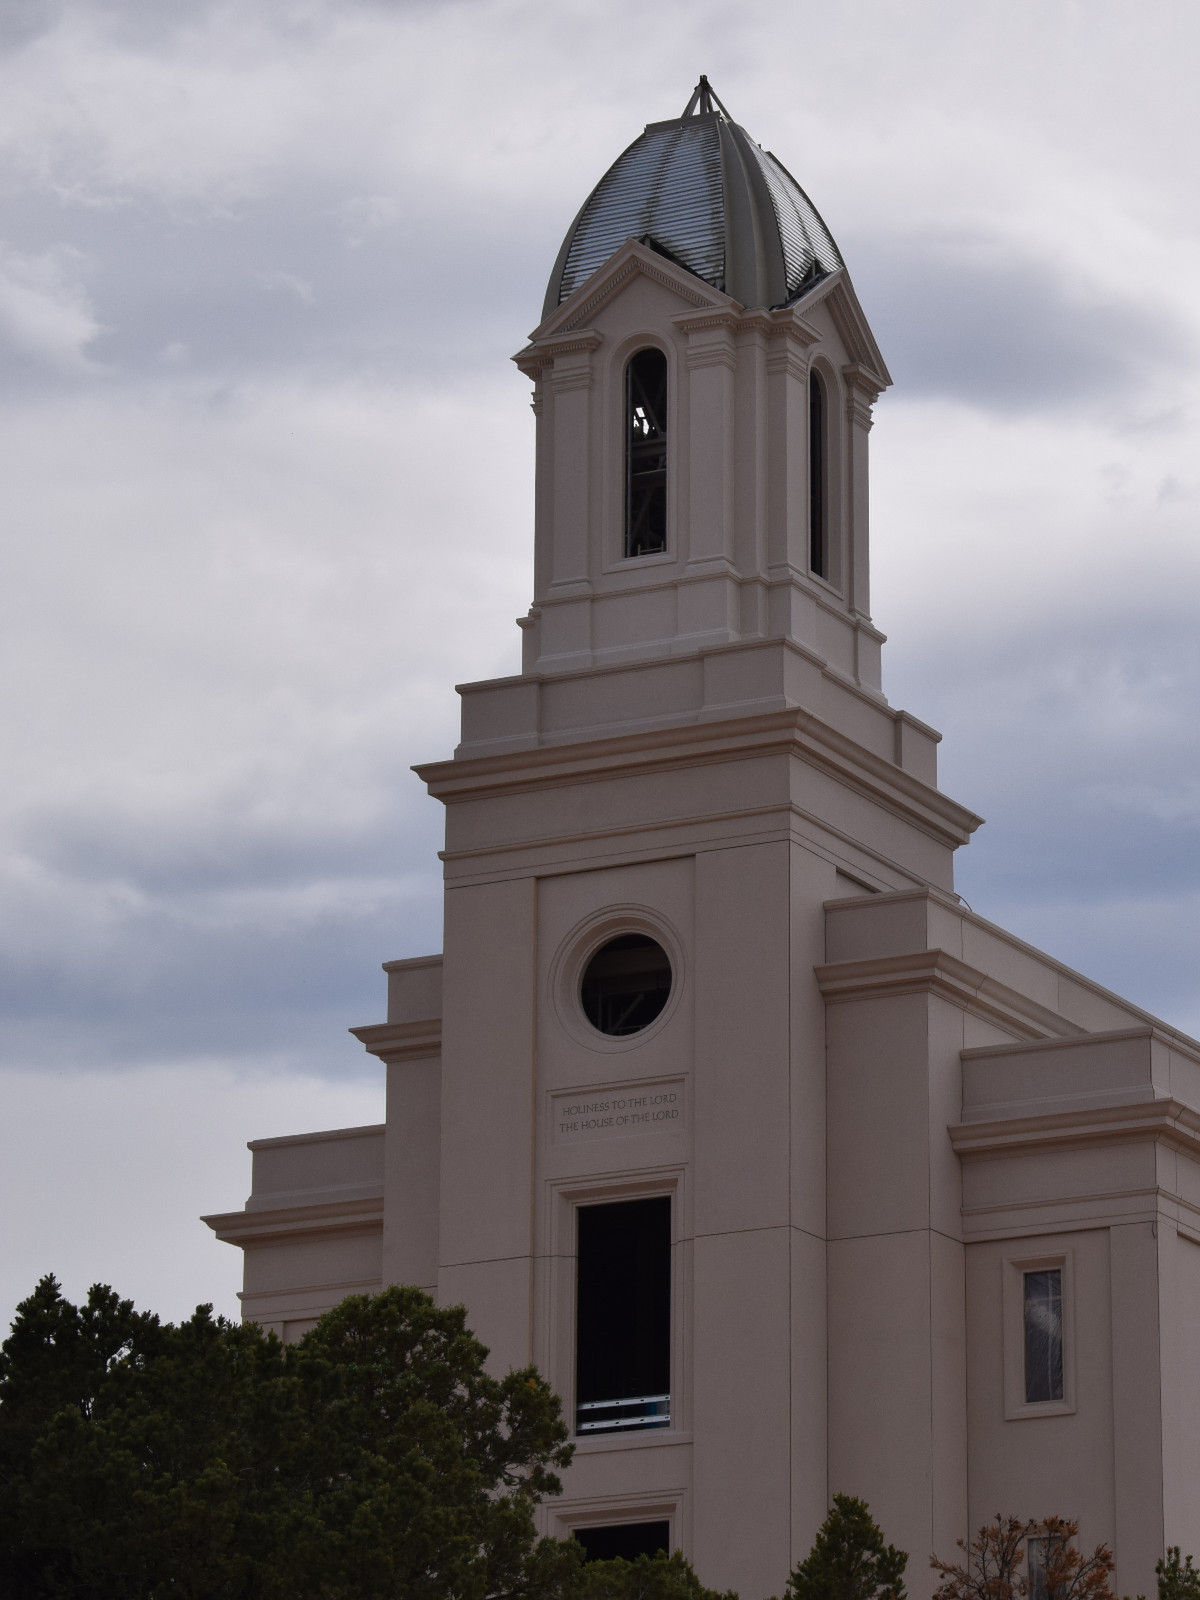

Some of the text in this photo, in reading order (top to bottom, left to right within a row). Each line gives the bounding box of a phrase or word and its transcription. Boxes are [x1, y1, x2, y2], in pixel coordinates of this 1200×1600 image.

[562, 1093, 677, 1116] HOLINESS TO THE LORD
[560, 1109, 679, 1133] THE HOUSE OF THE LORD
